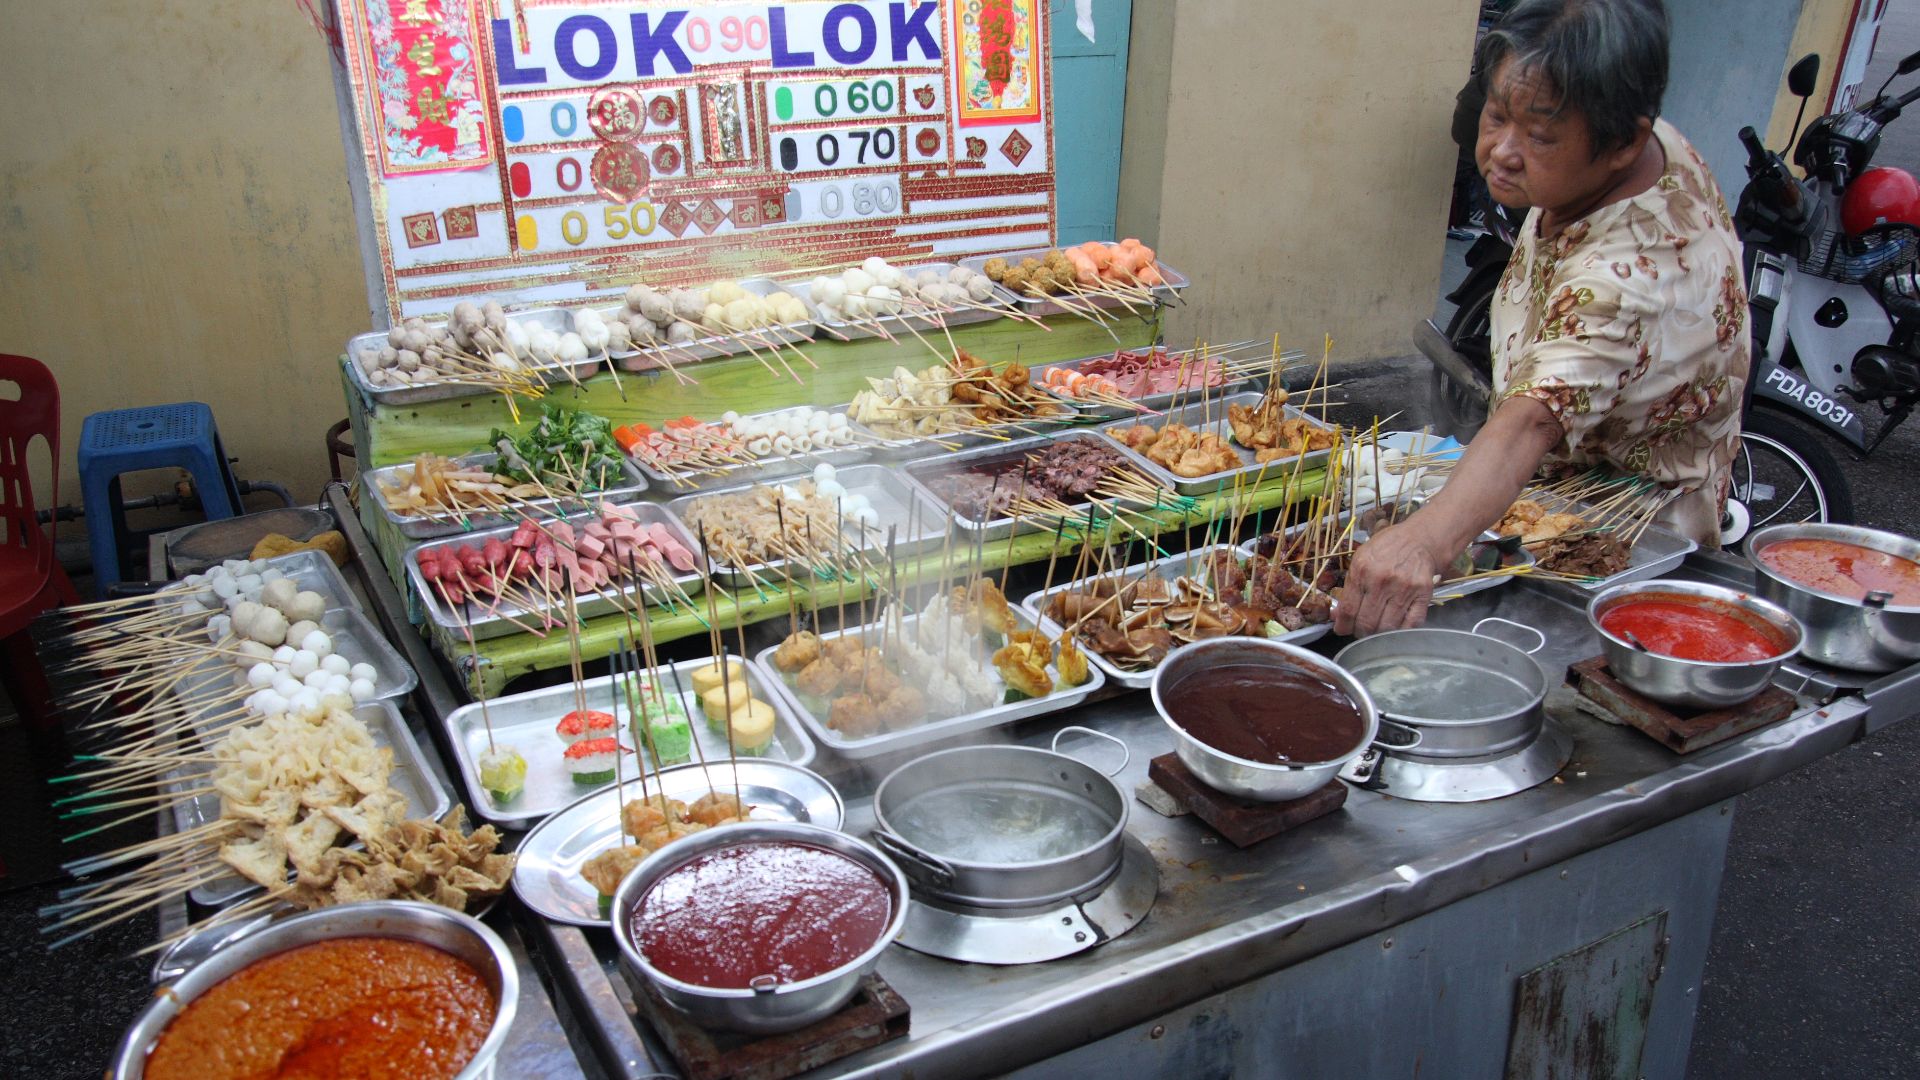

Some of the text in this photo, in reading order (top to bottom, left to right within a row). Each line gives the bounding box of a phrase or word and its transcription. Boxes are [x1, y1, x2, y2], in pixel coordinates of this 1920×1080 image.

[493, 2, 942, 84] LOK LOK
[847, 79, 894, 113] 60
[848, 128, 895, 164] 70
[604, 201, 656, 240] 50
[1765, 367, 1854, 428] PDA 8031
